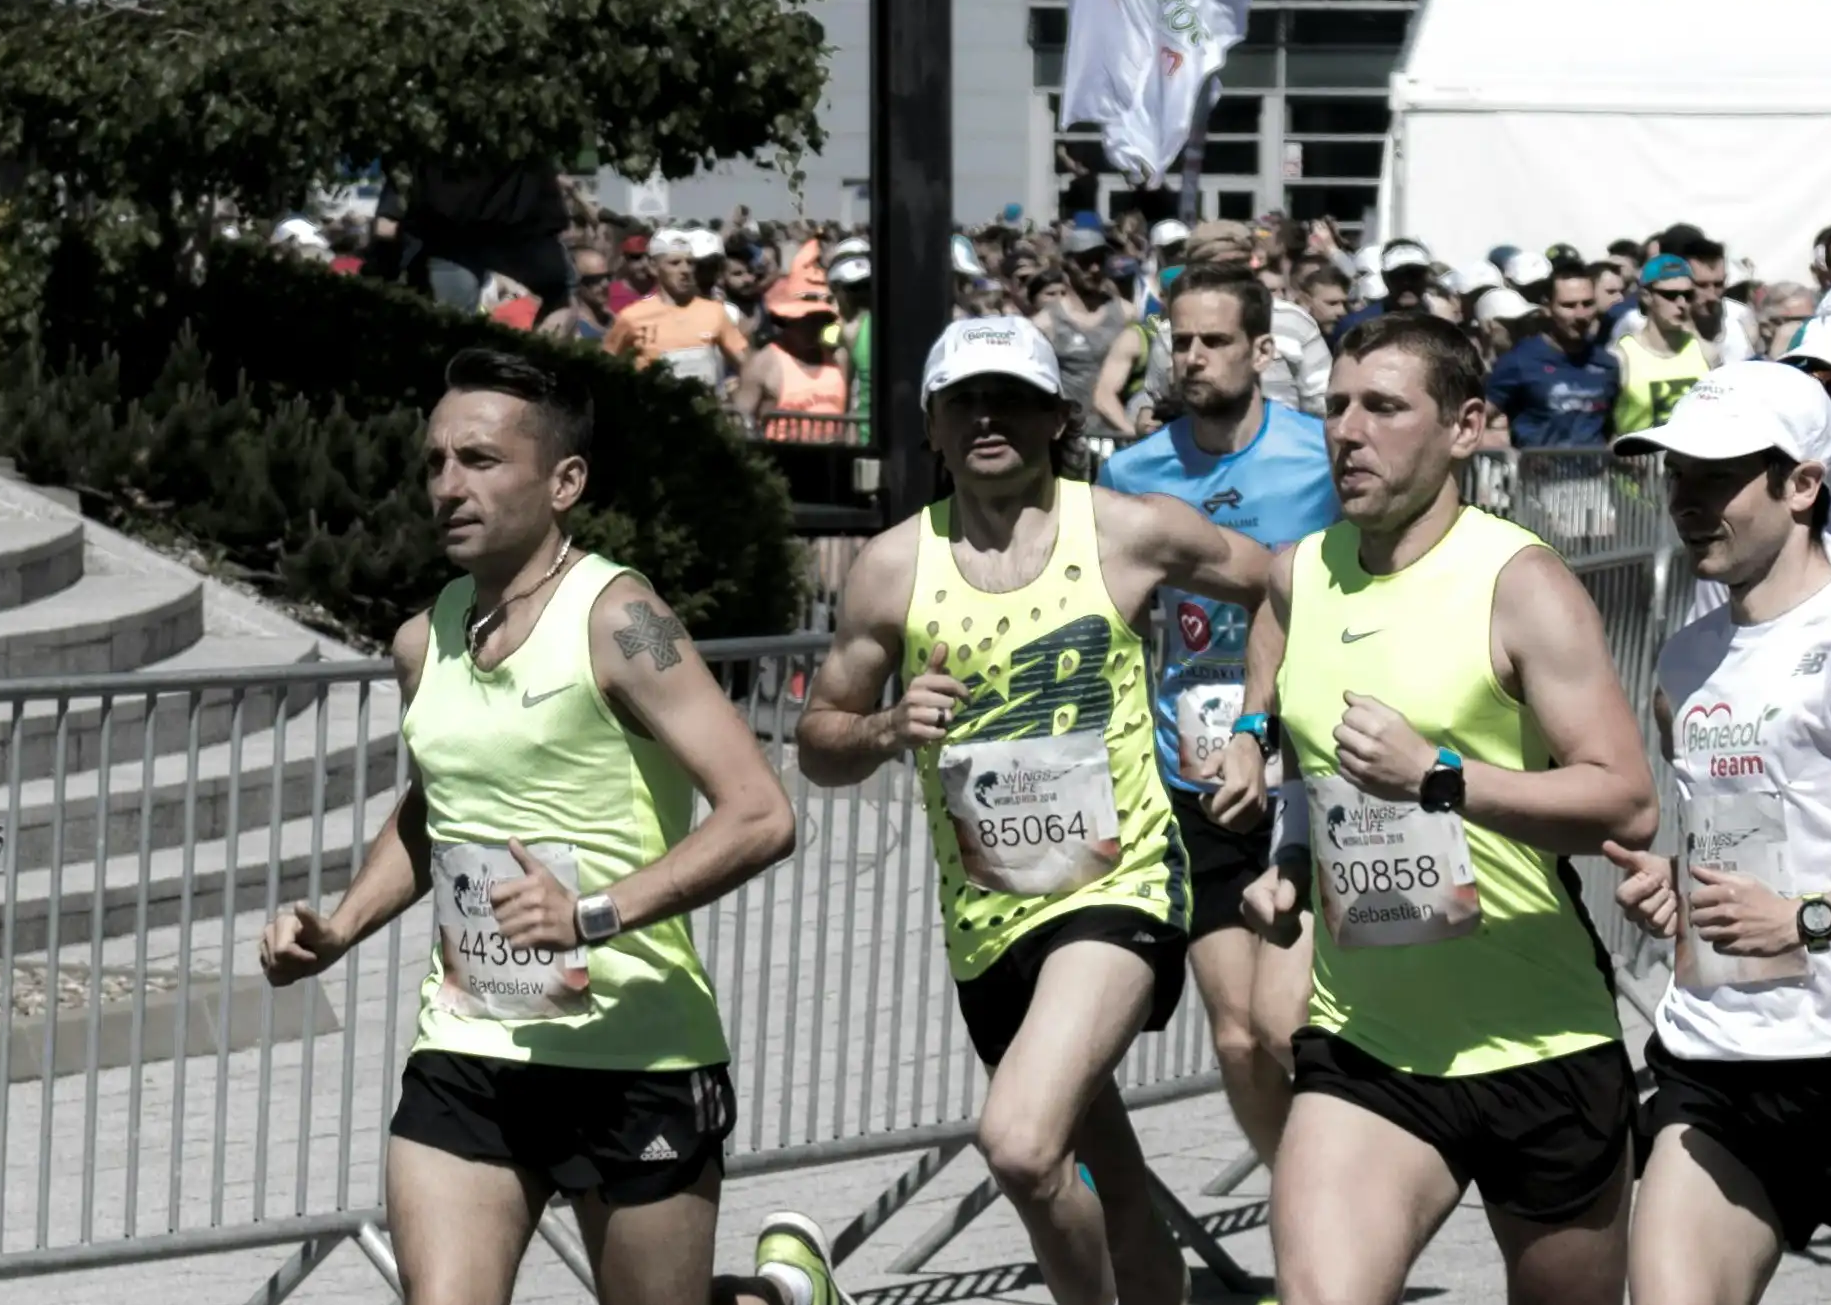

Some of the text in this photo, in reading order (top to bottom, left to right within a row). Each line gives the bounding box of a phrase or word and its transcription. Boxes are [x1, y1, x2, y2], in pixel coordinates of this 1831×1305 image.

[1687, 714, 1761, 753] Benecol
[1710, 754, 1764, 777] team
[1348, 806, 1397, 821] WINGS
[978, 810, 1089, 849] 85064
[1357, 820, 1385, 833] LIFE
[1331, 854, 1440, 896] 30858
[1347, 902, 1435, 925] Sebastian
[468, 974, 545, 996] Radosław
